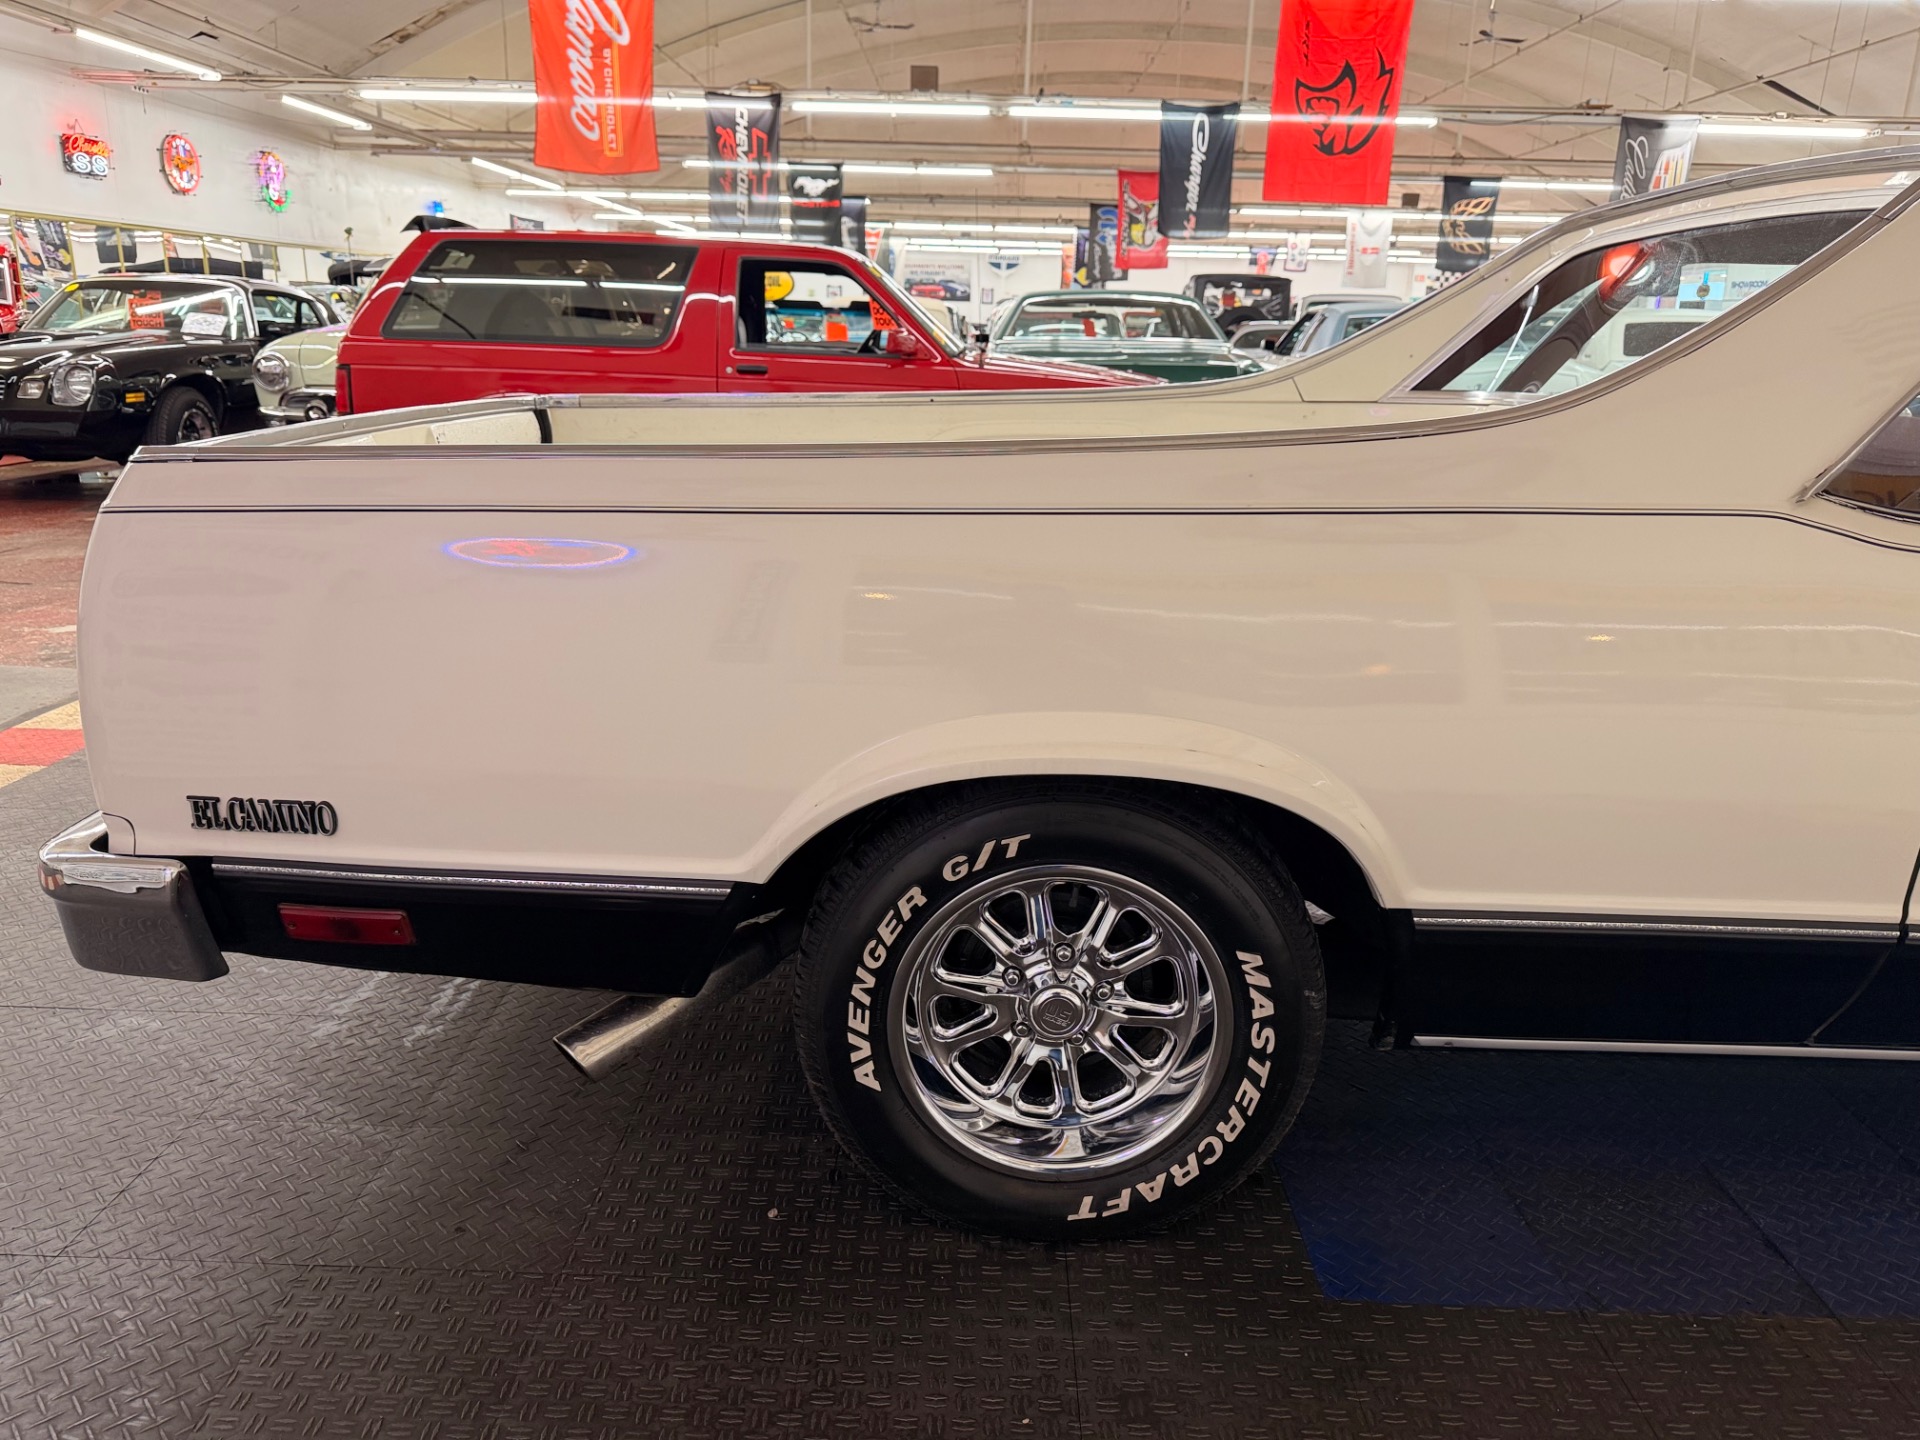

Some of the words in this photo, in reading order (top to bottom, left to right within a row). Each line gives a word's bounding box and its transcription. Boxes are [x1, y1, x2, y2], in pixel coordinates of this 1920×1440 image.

[602, 48, 612, 66] BY
[604, 68, 617, 150] CHEVROLET
[72, 151, 109, 176] SS
[735, 106, 749, 226] CHEVROLET
[1184, 112, 1210, 212] Charger
[132, 319, 162, 328] TOUCH
[874, 316, 894, 327] TOU
[847, 886, 928, 1092] AVENGER
[943, 833, 1031, 882] G/T
[1067, 950, 1276, 1221] MASTERCRAFT
